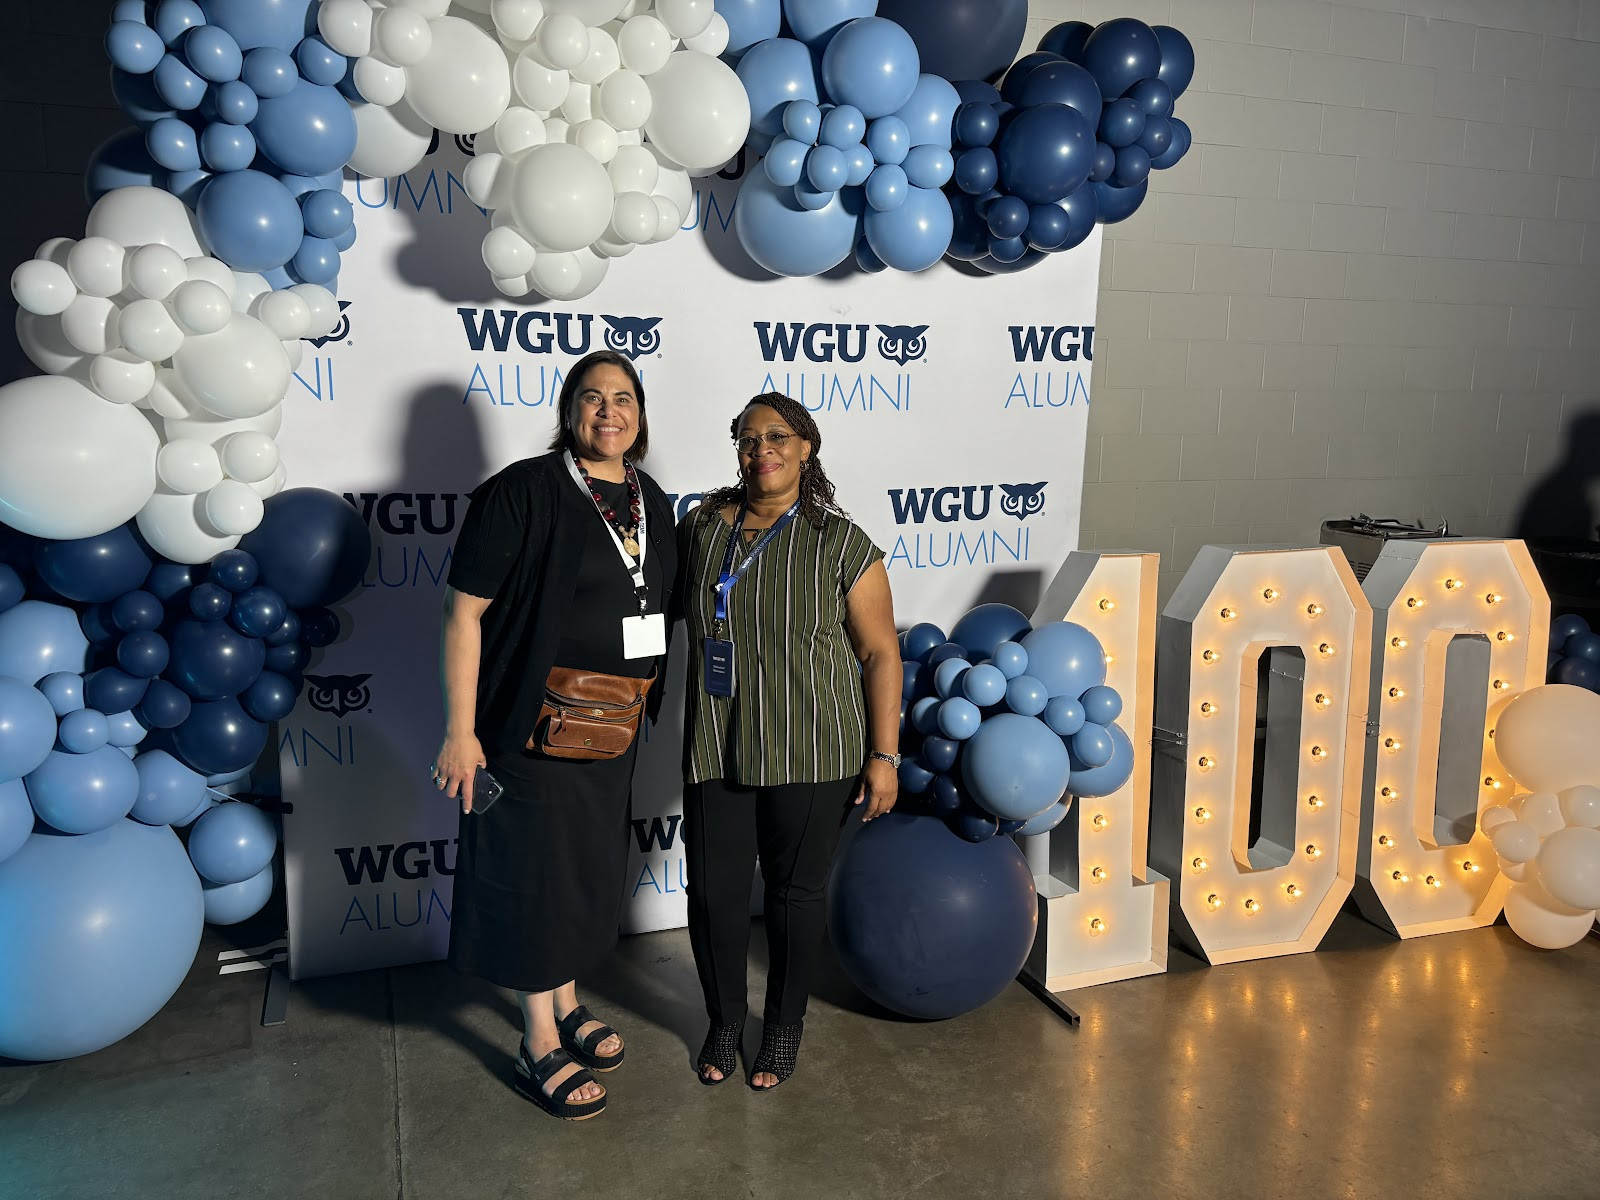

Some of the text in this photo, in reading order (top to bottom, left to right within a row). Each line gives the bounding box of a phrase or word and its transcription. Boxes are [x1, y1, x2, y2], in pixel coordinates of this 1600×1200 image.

[457, 308, 594, 356] WGU
[753, 322, 870, 363] WGU
[888, 485, 994, 524] WGU
[886, 527, 1029, 570] ALUMNI
[334, 838, 459, 885] WGU
